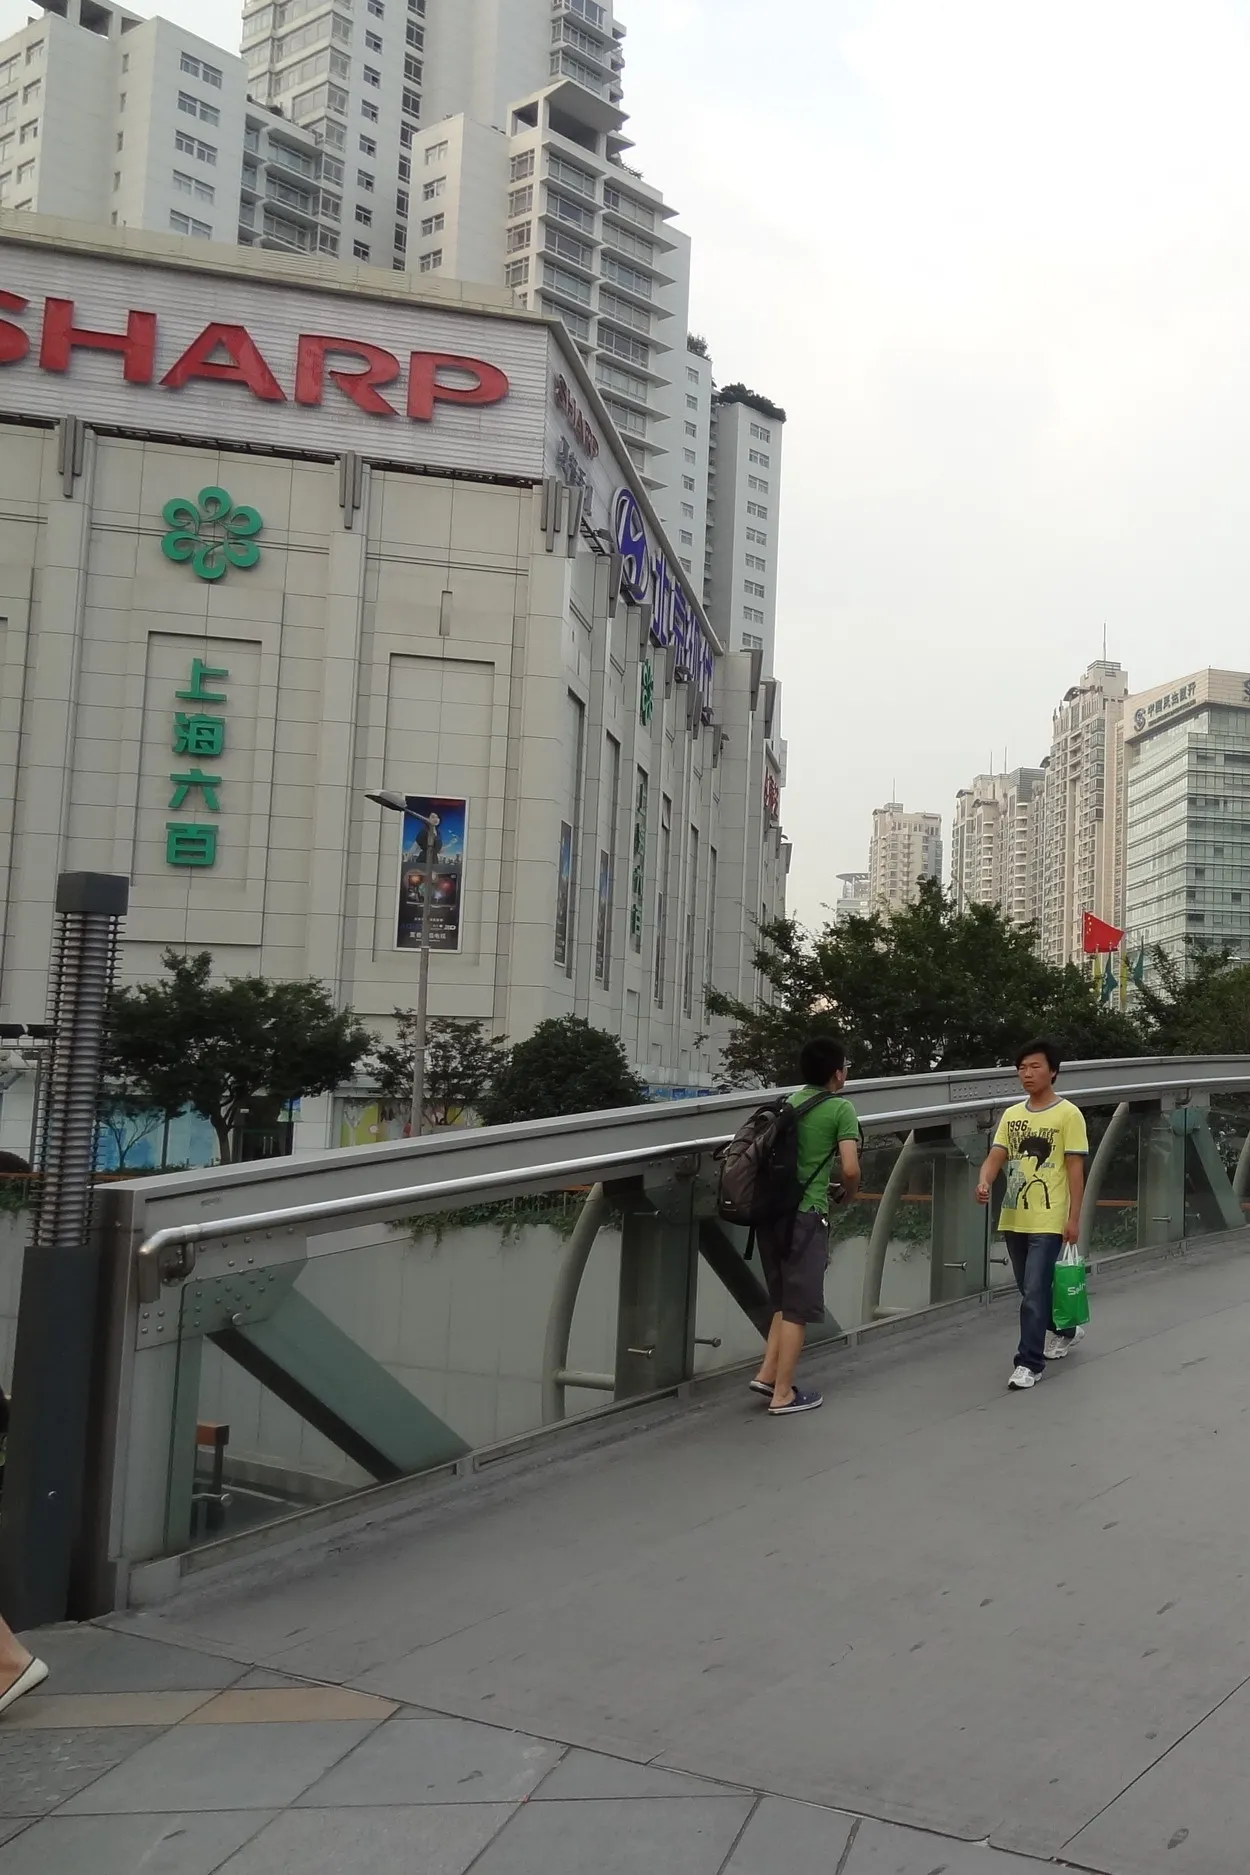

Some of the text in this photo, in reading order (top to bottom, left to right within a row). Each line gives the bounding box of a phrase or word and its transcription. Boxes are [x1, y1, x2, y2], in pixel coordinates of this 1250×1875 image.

[555, 372, 599, 461] SHARP
[165, 657, 229, 866] 上海六百
[1007, 1120, 1028, 1133] 1996
